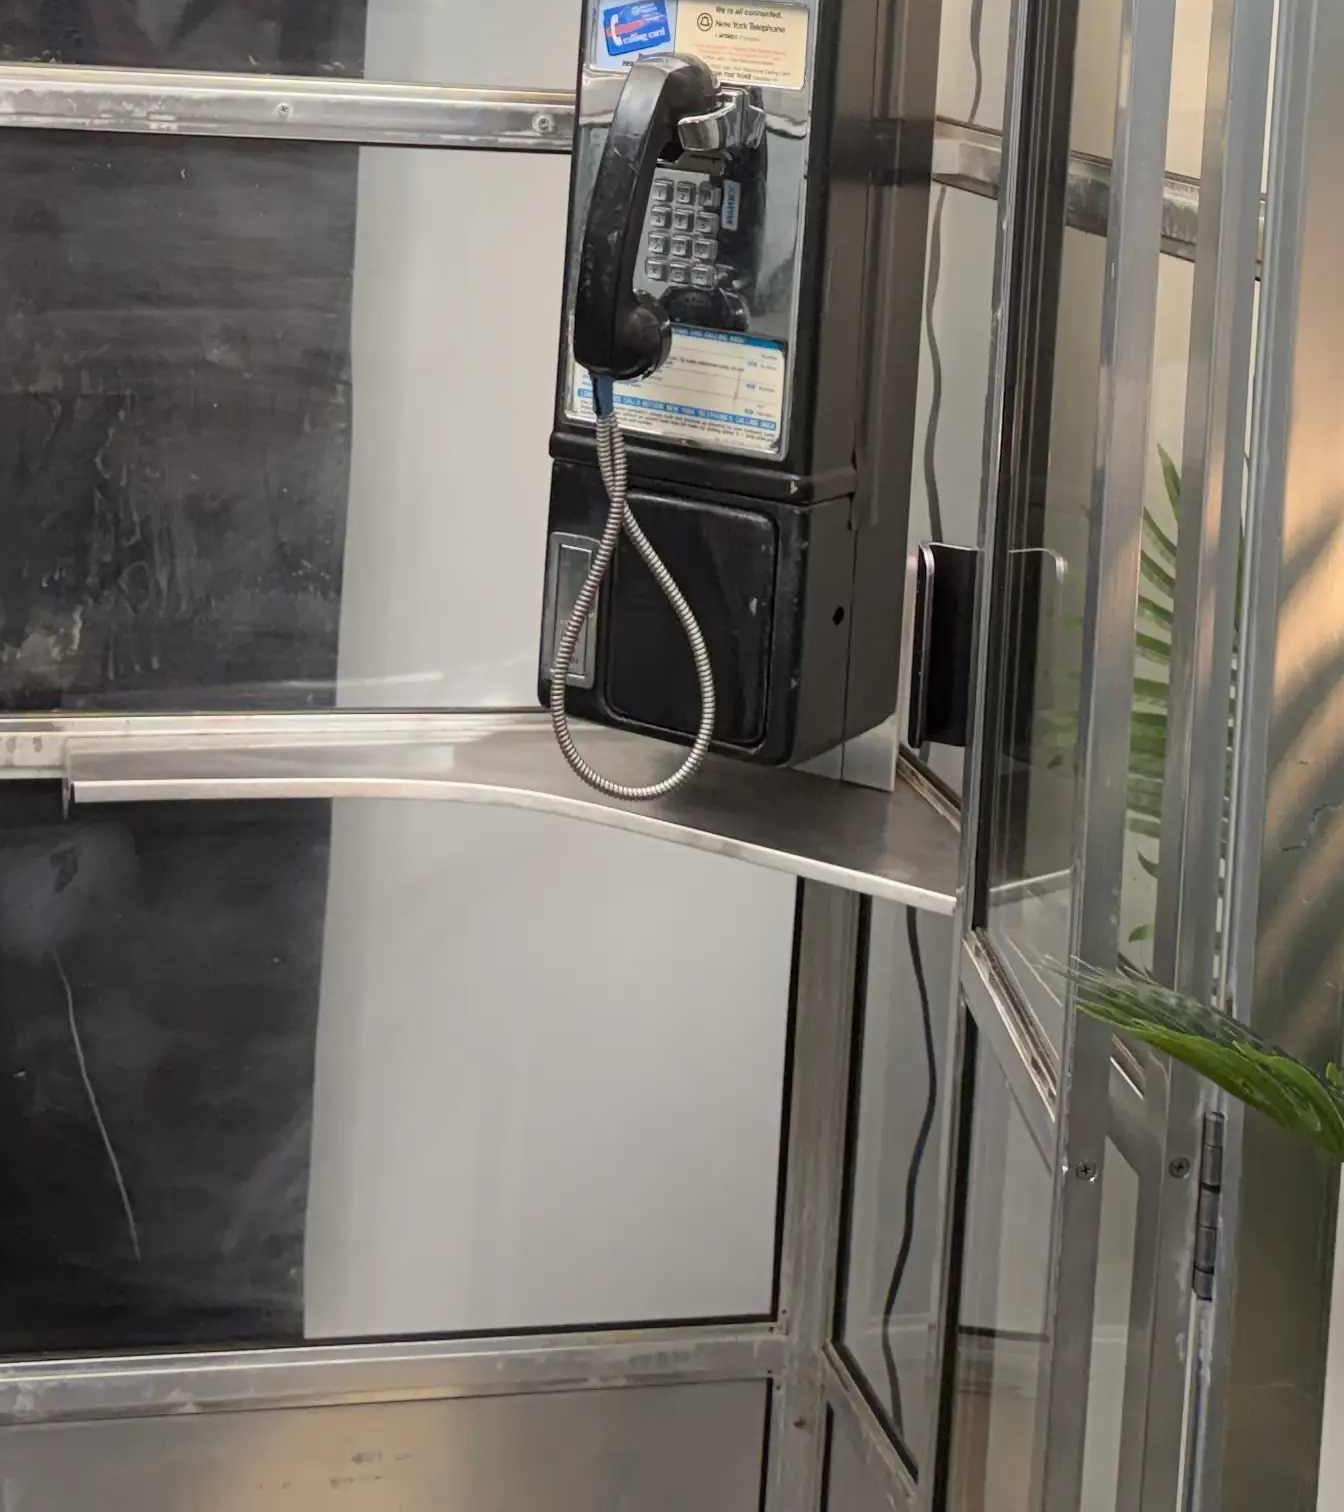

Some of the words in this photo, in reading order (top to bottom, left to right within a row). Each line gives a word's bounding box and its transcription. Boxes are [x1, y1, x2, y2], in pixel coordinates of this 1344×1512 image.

[715, 20, 731, 28] New
[733, 21, 748, 29] York
[749, 22, 786, 33] Telephone
[623, 32, 648, 45] calling
[648, 27, 666, 38] card
